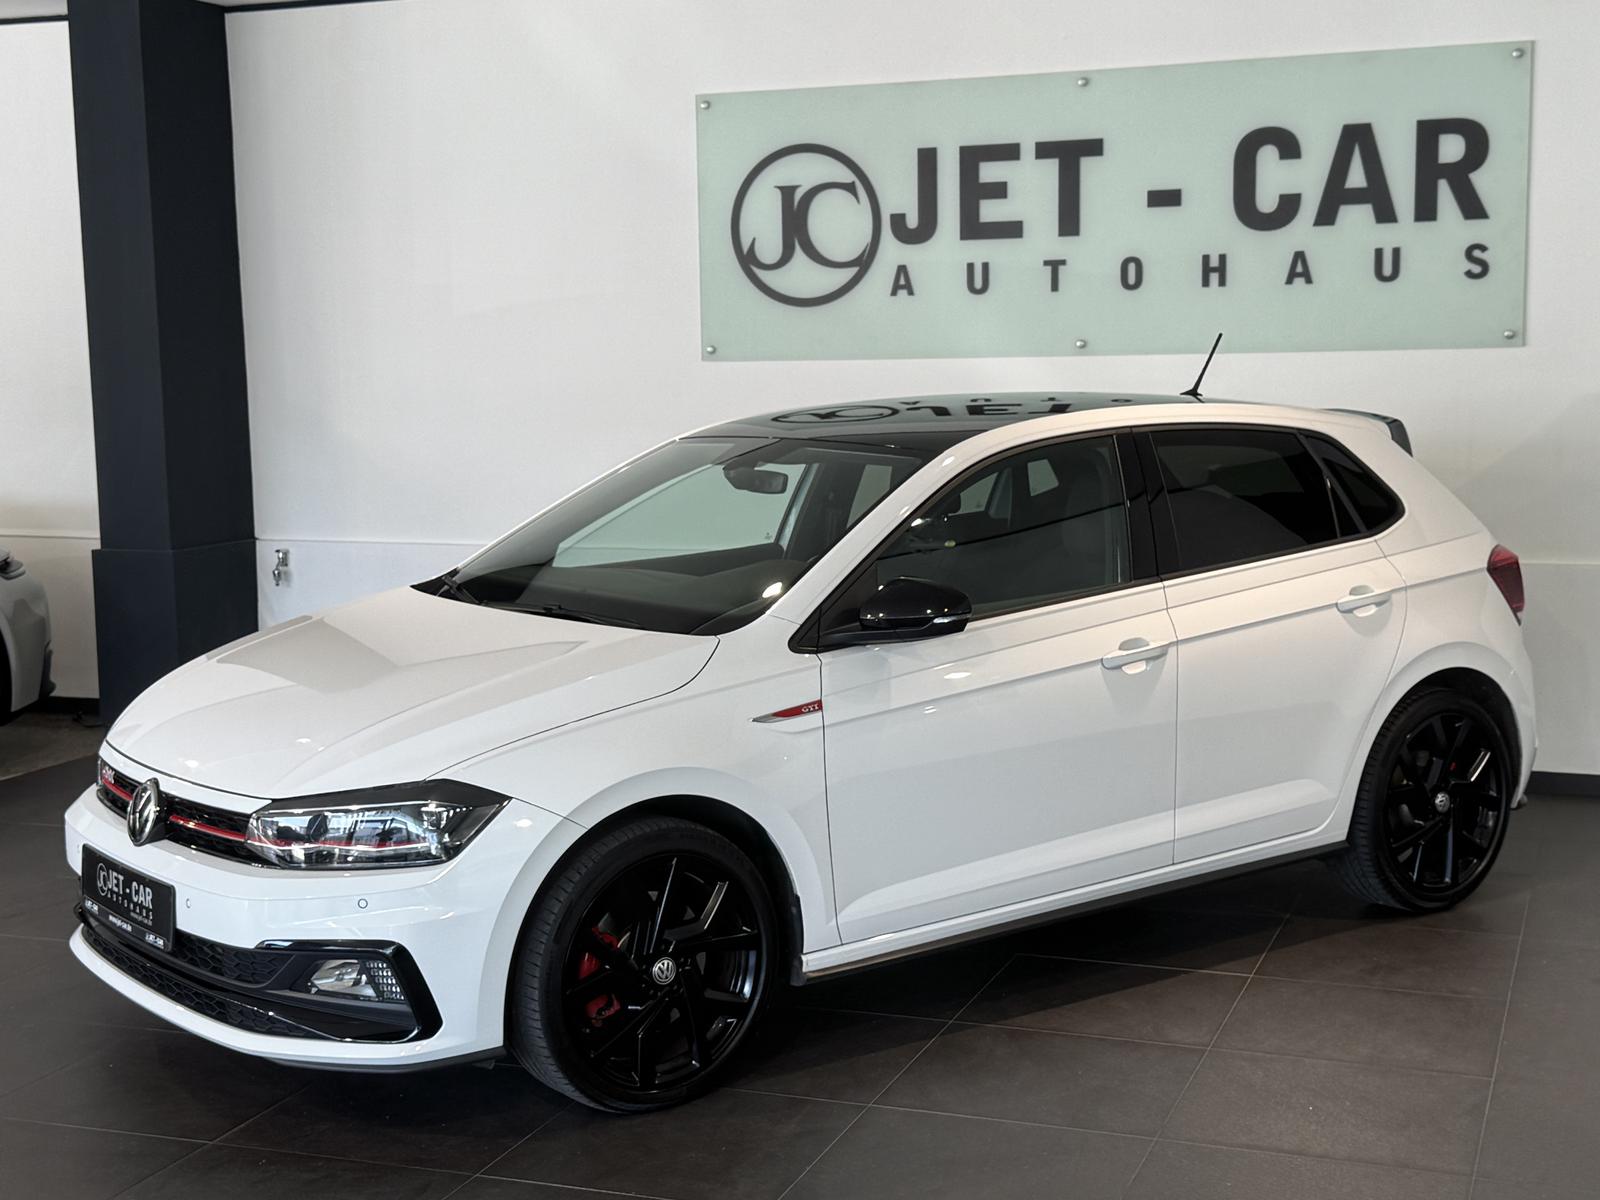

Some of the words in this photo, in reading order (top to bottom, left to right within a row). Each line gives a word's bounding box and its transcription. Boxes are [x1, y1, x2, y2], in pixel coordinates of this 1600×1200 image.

[890, 138, 1104, 246] JET
[1146, 188, 1182, 209] -
[1232, 117, 1490, 231] CAR
[743, 181, 870, 271] JC
[890, 243, 1490, 297] AUTOHAUS
[801, 703, 819, 713] GTI
[107, 869, 124, 894] JET
[131, 881, 153, 909] CAR
